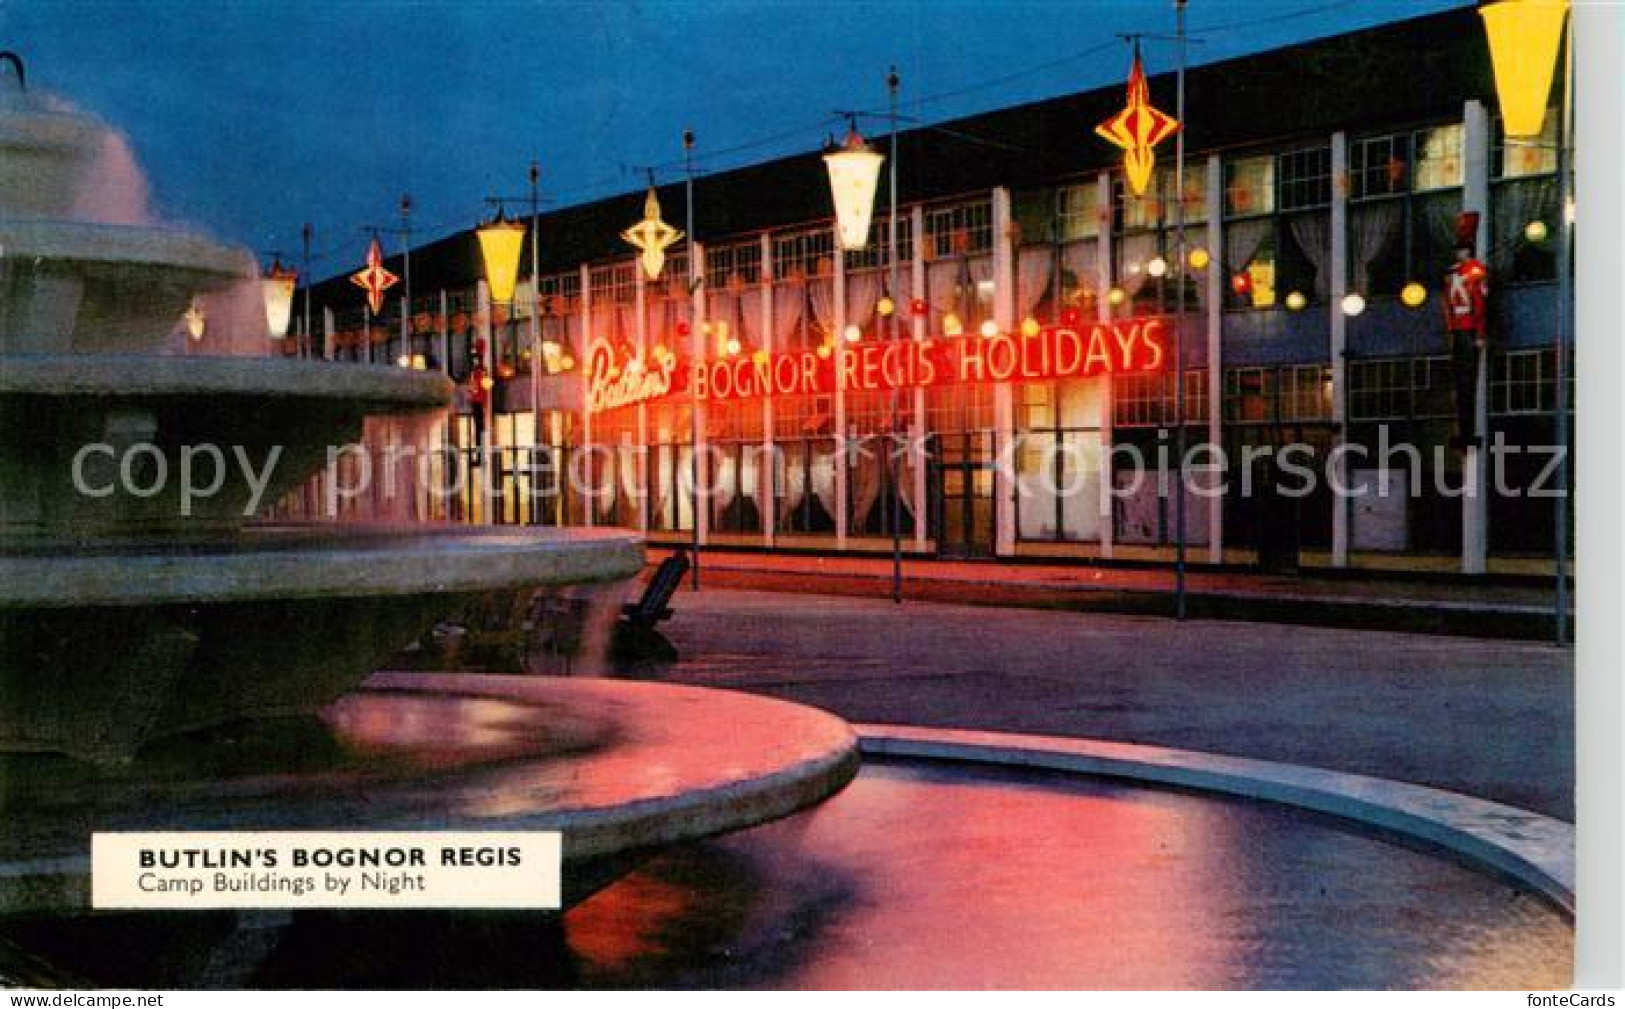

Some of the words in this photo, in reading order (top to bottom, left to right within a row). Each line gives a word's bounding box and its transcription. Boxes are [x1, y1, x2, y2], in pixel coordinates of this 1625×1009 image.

[696, 353, 818, 399] BOGNOR
[840, 340, 935, 392] REGIS
[960, 319, 1162, 381] HOLIDAYS
